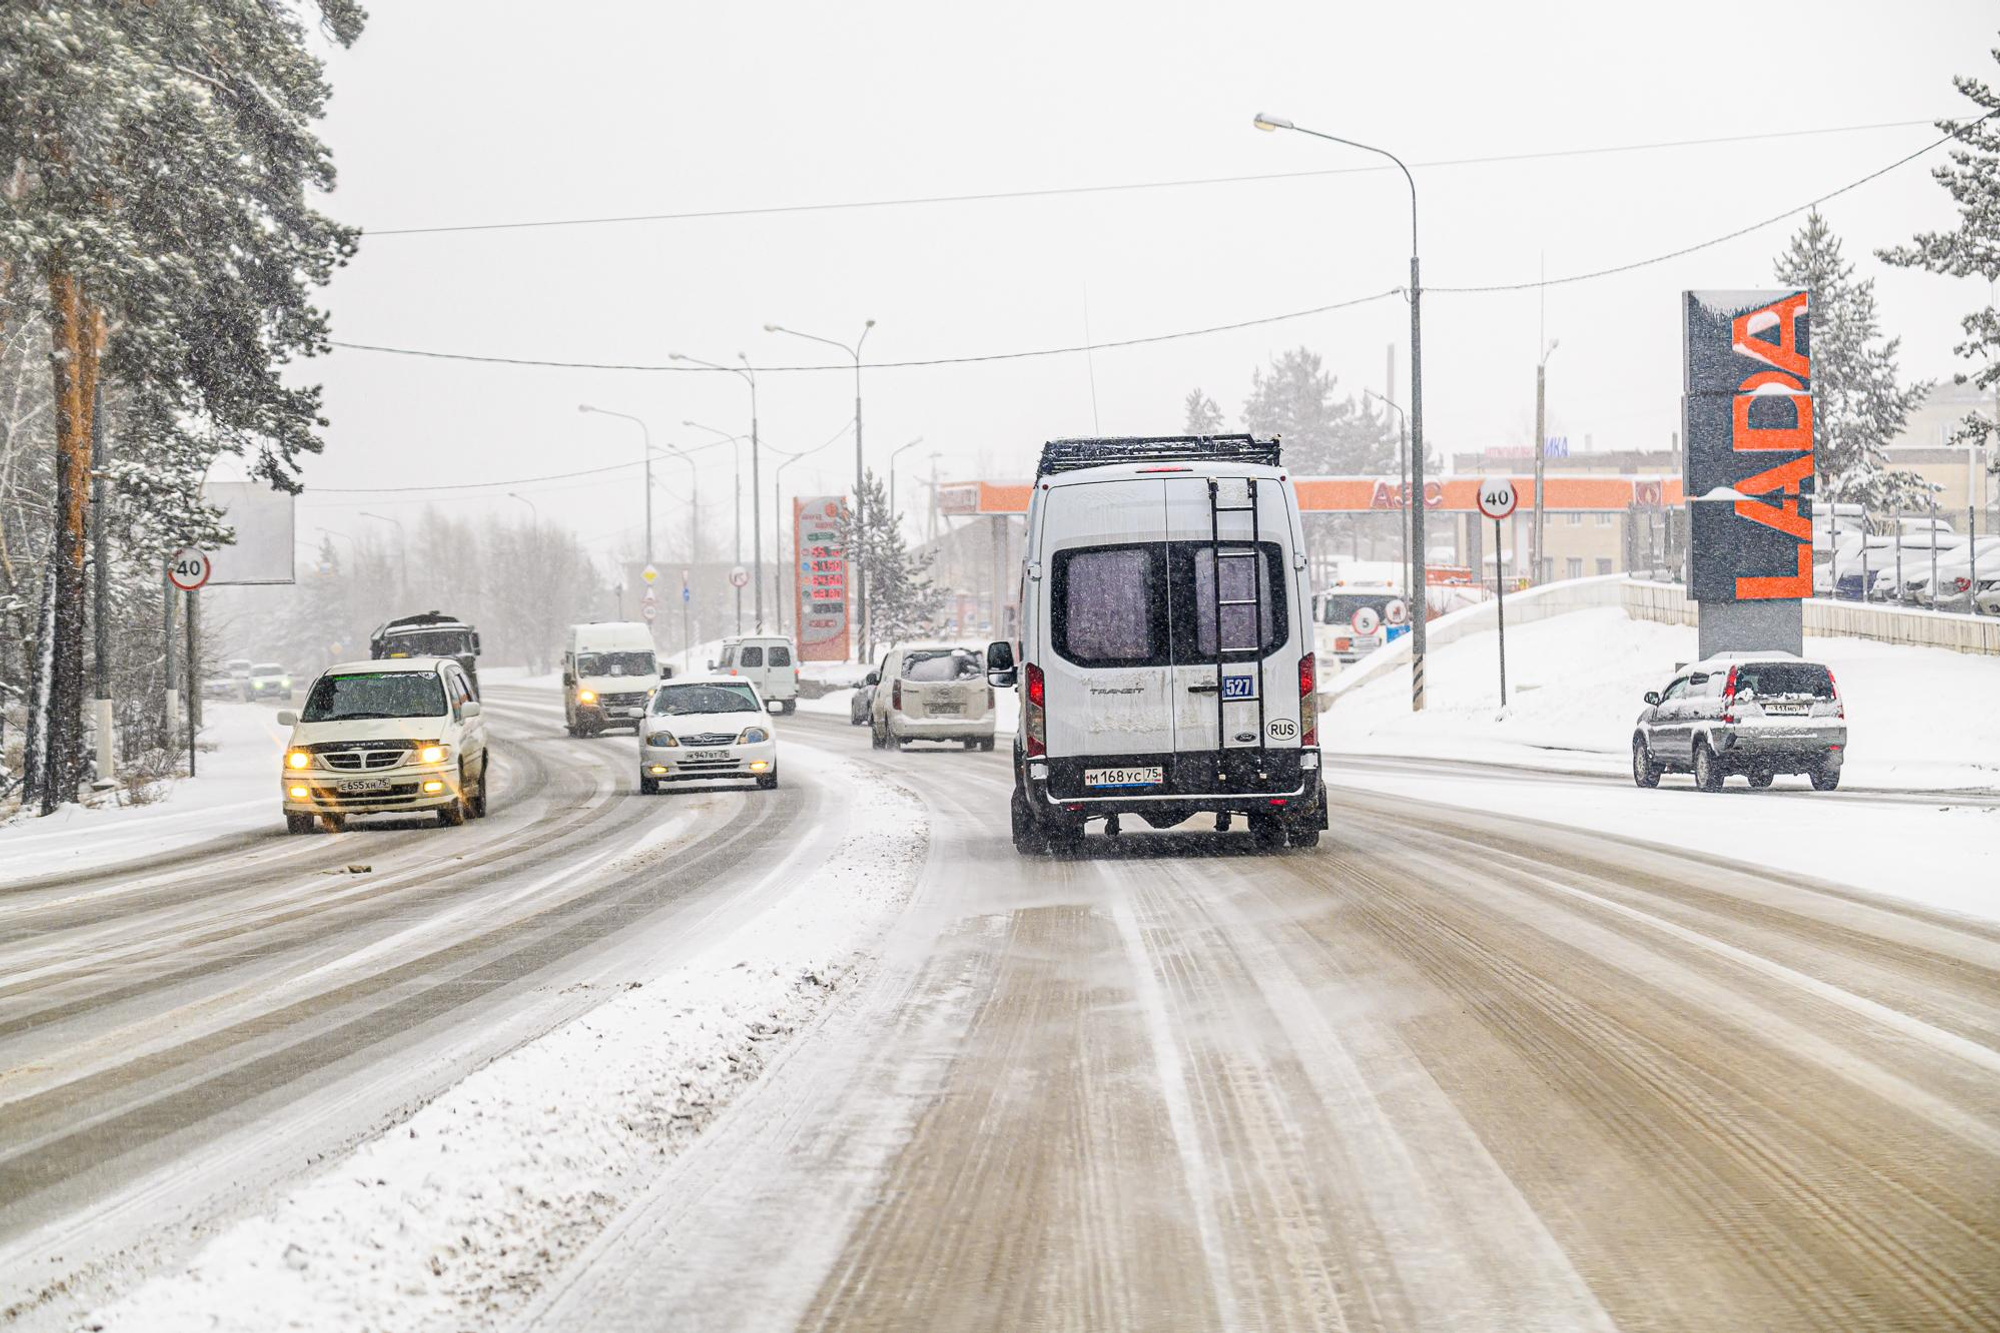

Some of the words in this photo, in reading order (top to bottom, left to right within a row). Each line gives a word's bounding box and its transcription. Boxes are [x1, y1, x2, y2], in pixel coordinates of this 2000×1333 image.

[1732, 291, 1813, 599] LADA
[1372, 481, 1443, 508] АЗС
[1485, 490, 1508, 506] 40
[176, 560, 201, 576] 40
[1362, 617, 1370, 628] 5
[1226, 678, 1250, 696] 527
[1270, 723, 1295, 736] RUS
